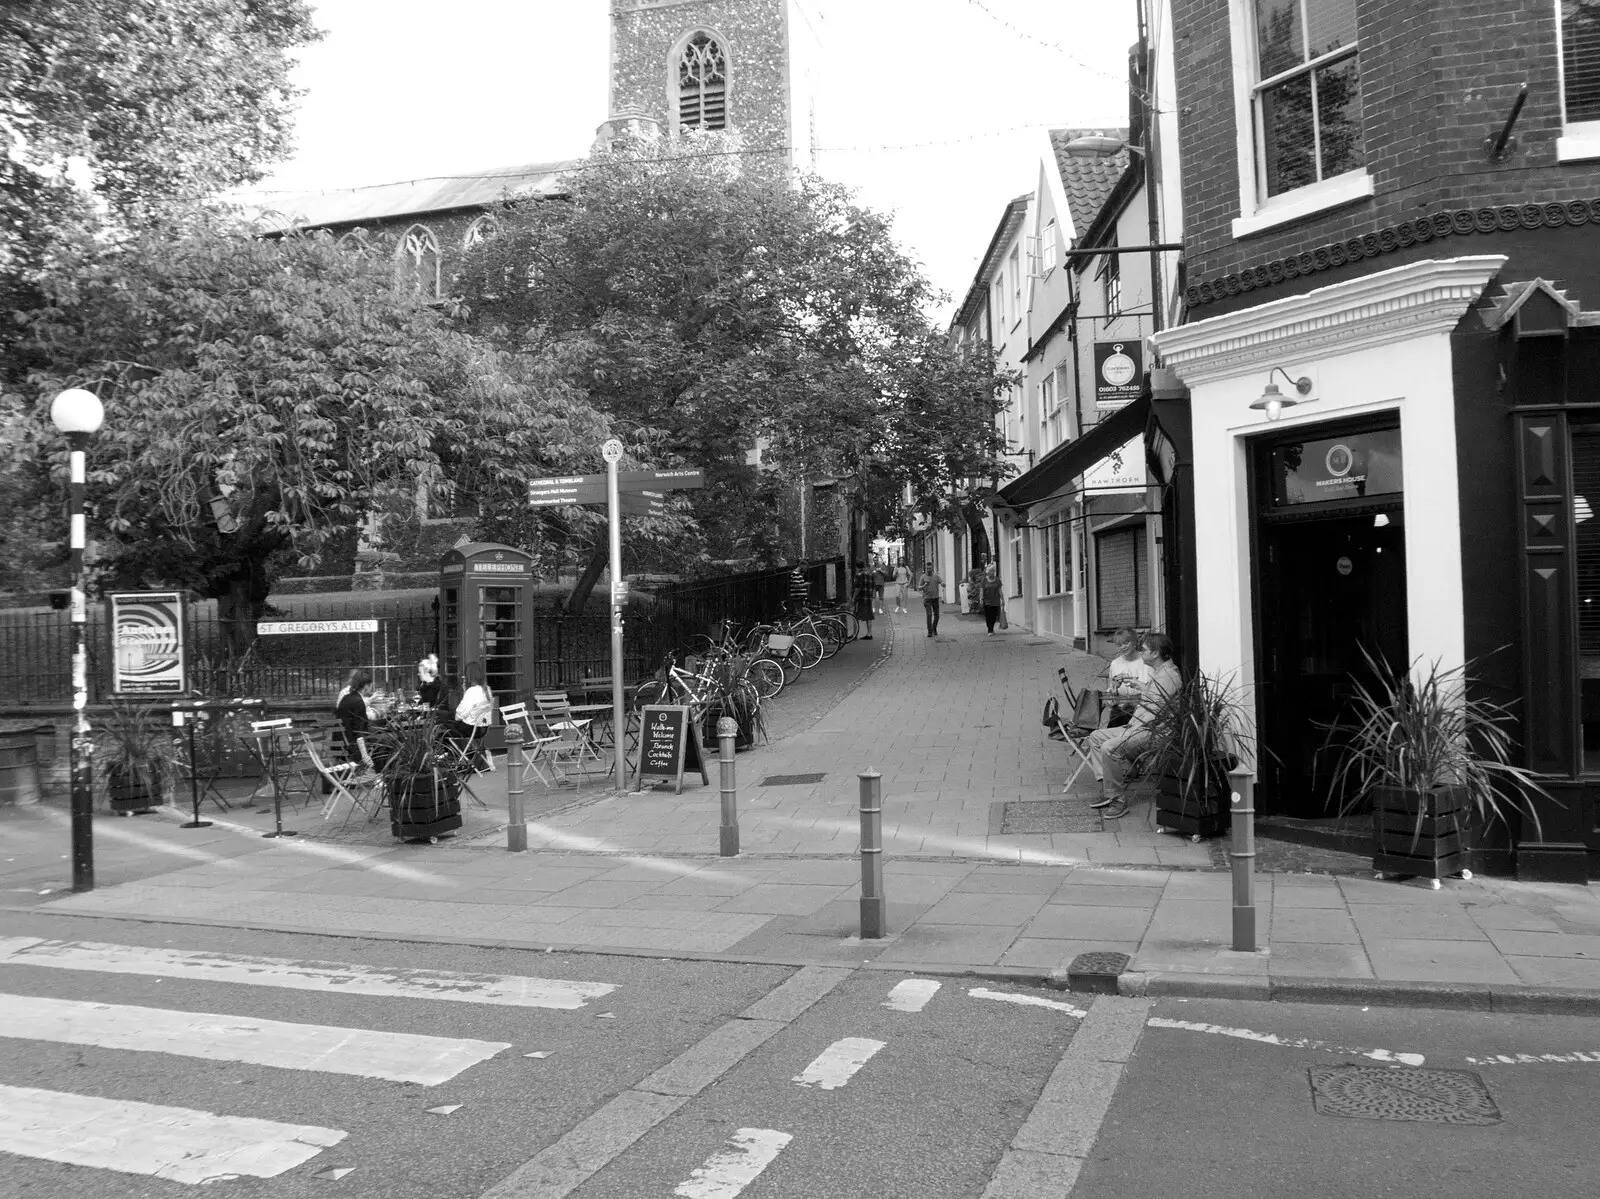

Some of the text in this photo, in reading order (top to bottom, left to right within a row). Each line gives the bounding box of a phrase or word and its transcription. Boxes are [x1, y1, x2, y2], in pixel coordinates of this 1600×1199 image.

[1316, 478, 1342, 486] MAKERS
[474, 564, 524, 572] TELEPHONE
[279, 622, 338, 632] GREGORYS
[341, 621, 372, 630] ALLEY
[648, 750, 672, 758] Cocktails
